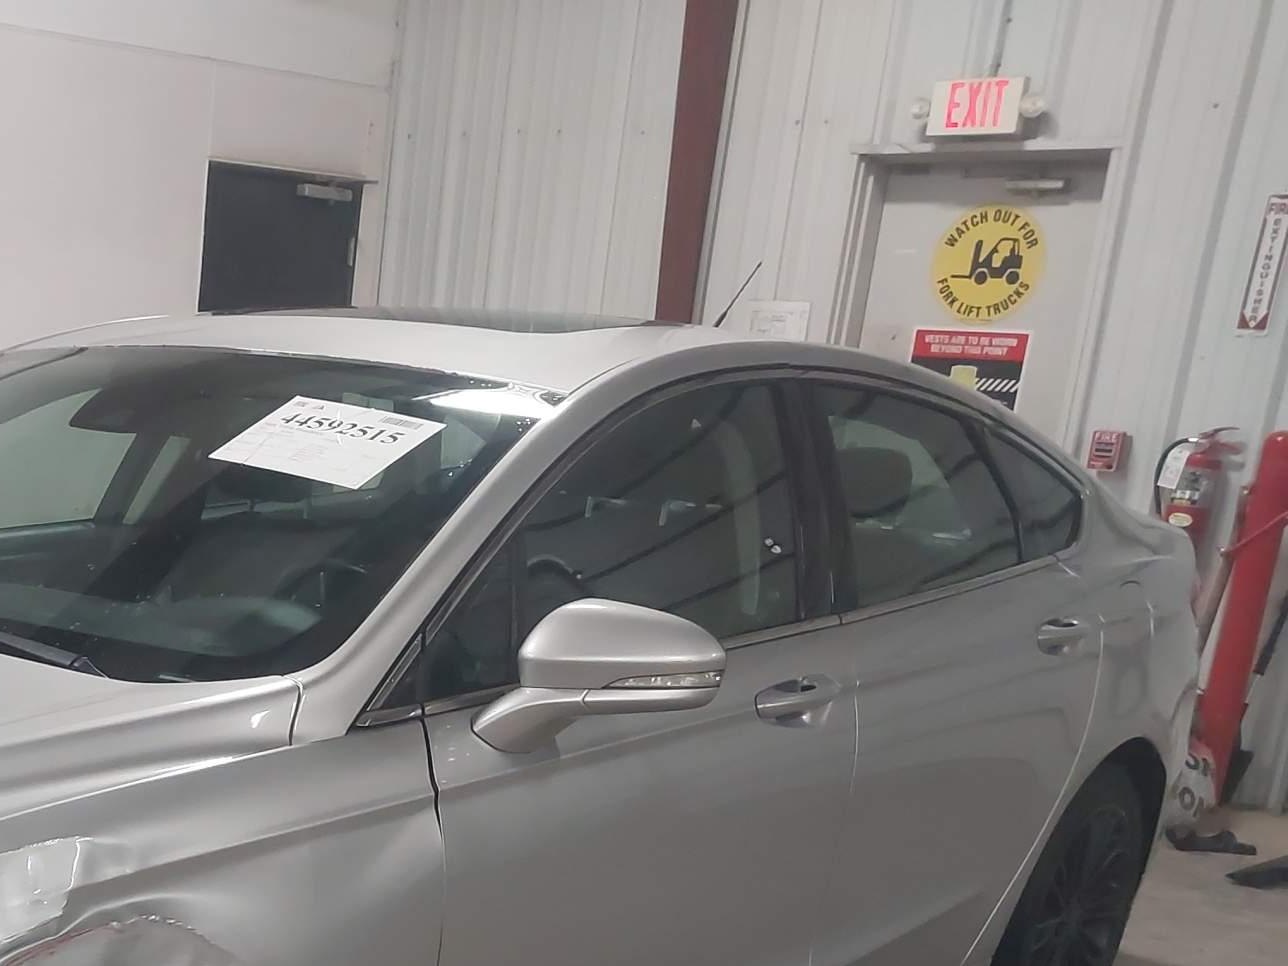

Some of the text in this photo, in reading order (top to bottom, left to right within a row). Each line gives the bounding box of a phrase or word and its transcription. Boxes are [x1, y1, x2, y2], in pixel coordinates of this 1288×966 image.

[945, 79, 1010, 128] EXIT
[945, 208, 1039, 249] WATCH OUT FOR
[1249, 218, 1282, 323] EXTINGUISHER
[937, 277, 1030, 318] FORK LIFT TRUCKS
[968, 336, 979, 345] TO
[280, 413, 406, 444] 44592515
[1094, 431, 1121, 442] FIRE
